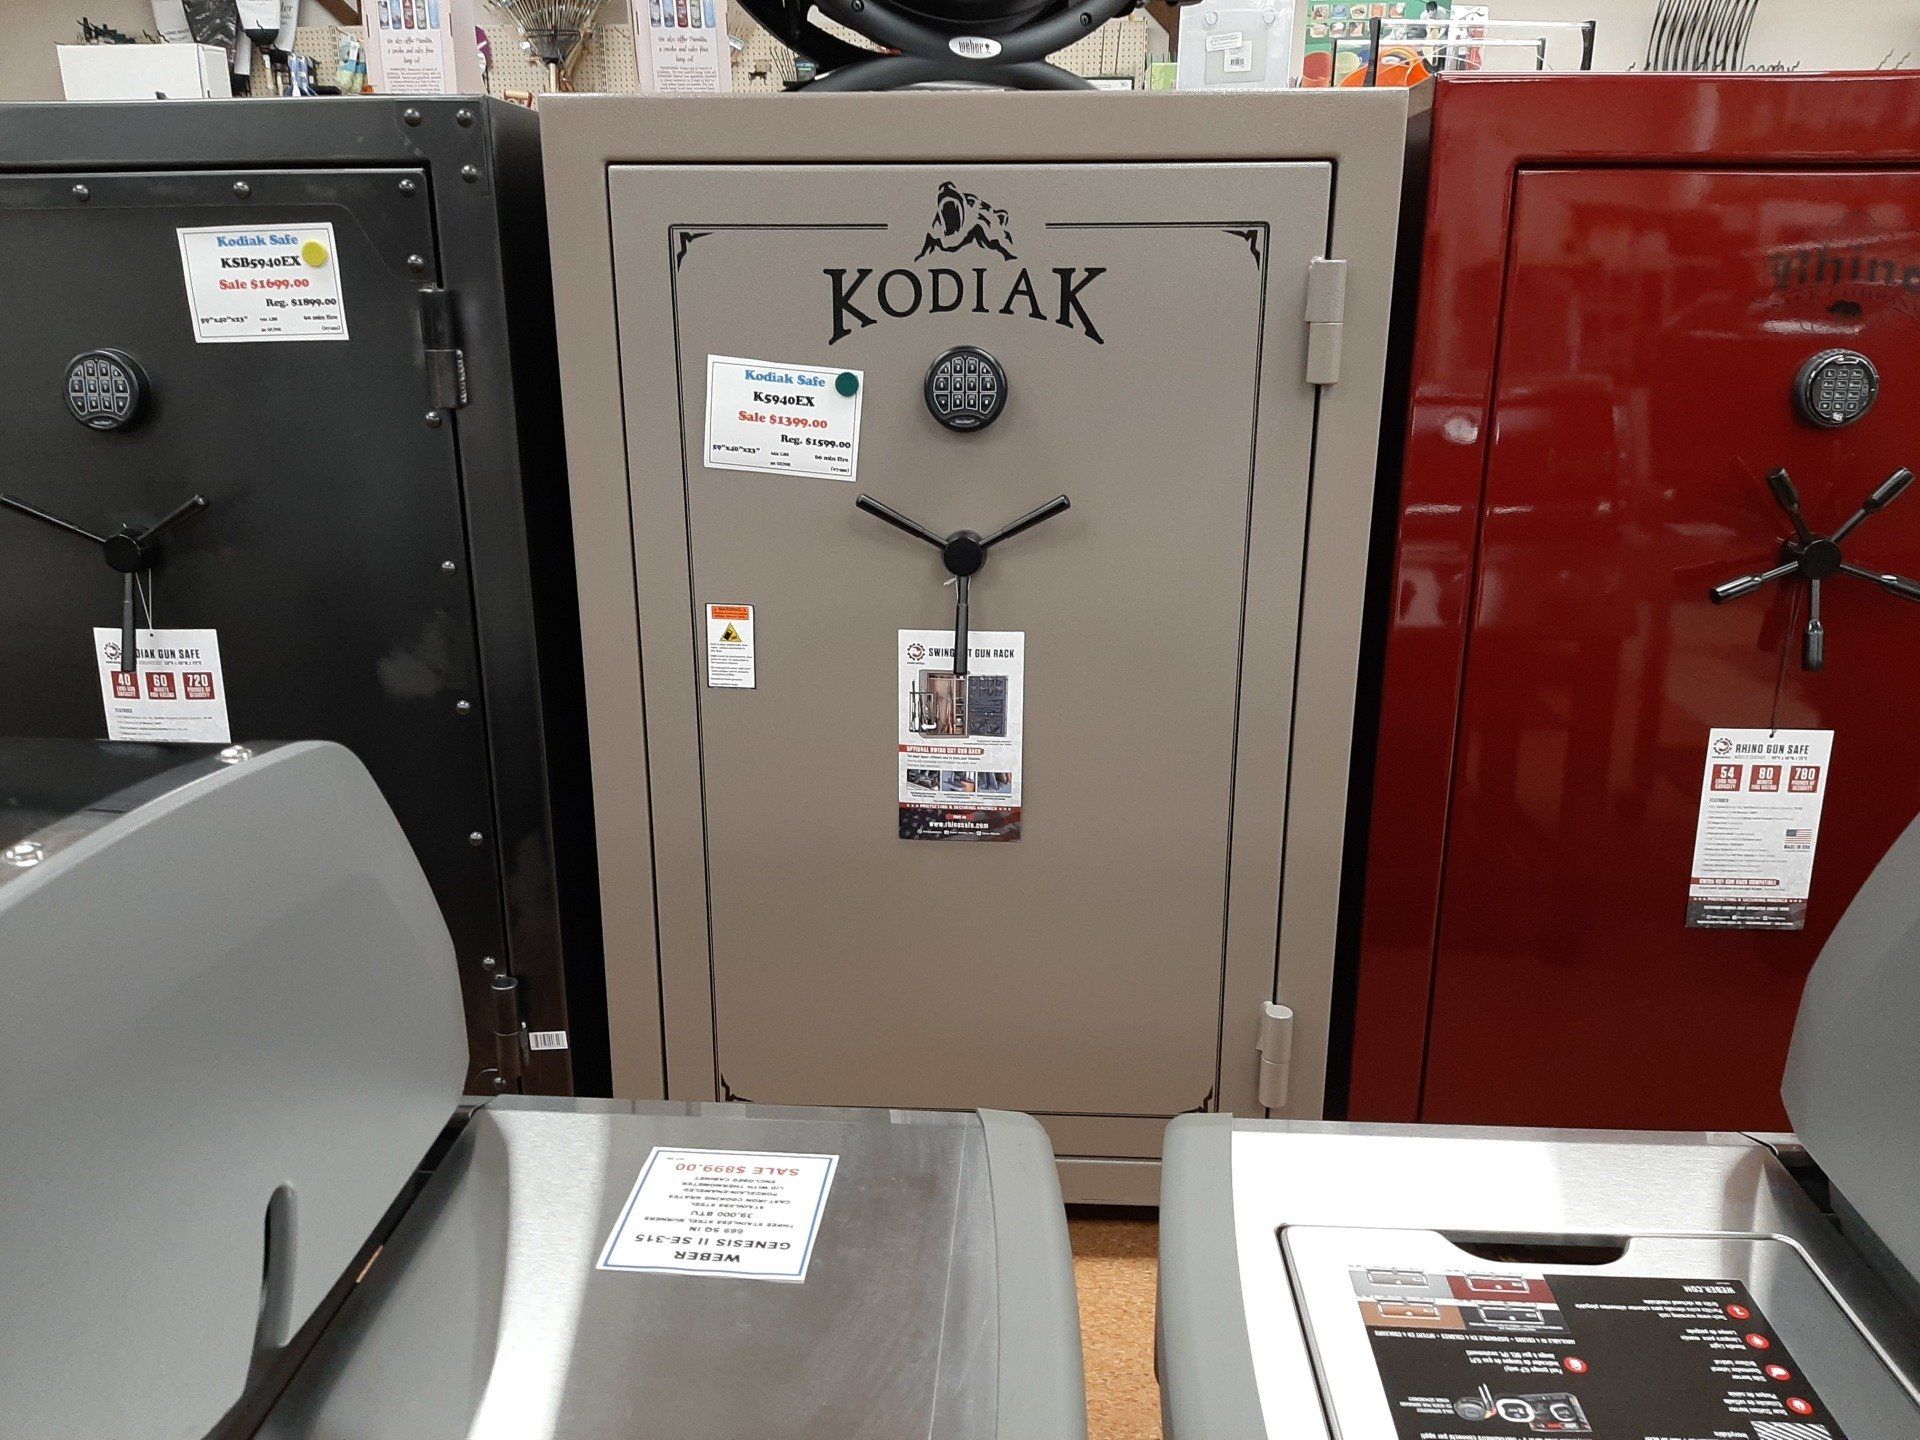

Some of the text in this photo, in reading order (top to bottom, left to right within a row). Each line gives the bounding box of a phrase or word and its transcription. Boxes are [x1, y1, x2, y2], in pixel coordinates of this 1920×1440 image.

[217, 235, 298, 247] Kodiak Safe
[221, 256, 301, 268] KSB5940EX
[219, 278, 309, 290] Sale $1699.00
[266, 298, 337, 307] Reg. $1899.00
[823, 267, 1107, 345] KODIAK
[745, 370, 825, 387] Kodiak Safe
[753, 391, 815, 407] K5940EX
[739, 411, 827, 429] Sale $1399.00
[781, 435, 851, 449] Reg. $1599.00
[158, 650, 176, 658] GUN
[179, 650, 200, 658] SAFE
[975, 649, 990, 658] GUN
[994, 649, 1014, 658] RACK
[118, 674, 130, 686] 40
[153, 675, 168, 686] 60
[187, 675, 208, 686] 720
[1736, 744, 1809, 754] RHINO GUN SAFE
[1721, 767, 1734, 778] 54
[1795, 768, 1815, 779] 780
[675, 1163, 799, 1176] SALE $899.00
[634, 1234, 692, 1244] SE-315
[716, 1238, 791, 1250] GENESIS
[673, 1251, 740, 1262] WEBER
[1682, 1285, 1736, 1294] WEBER.COM
